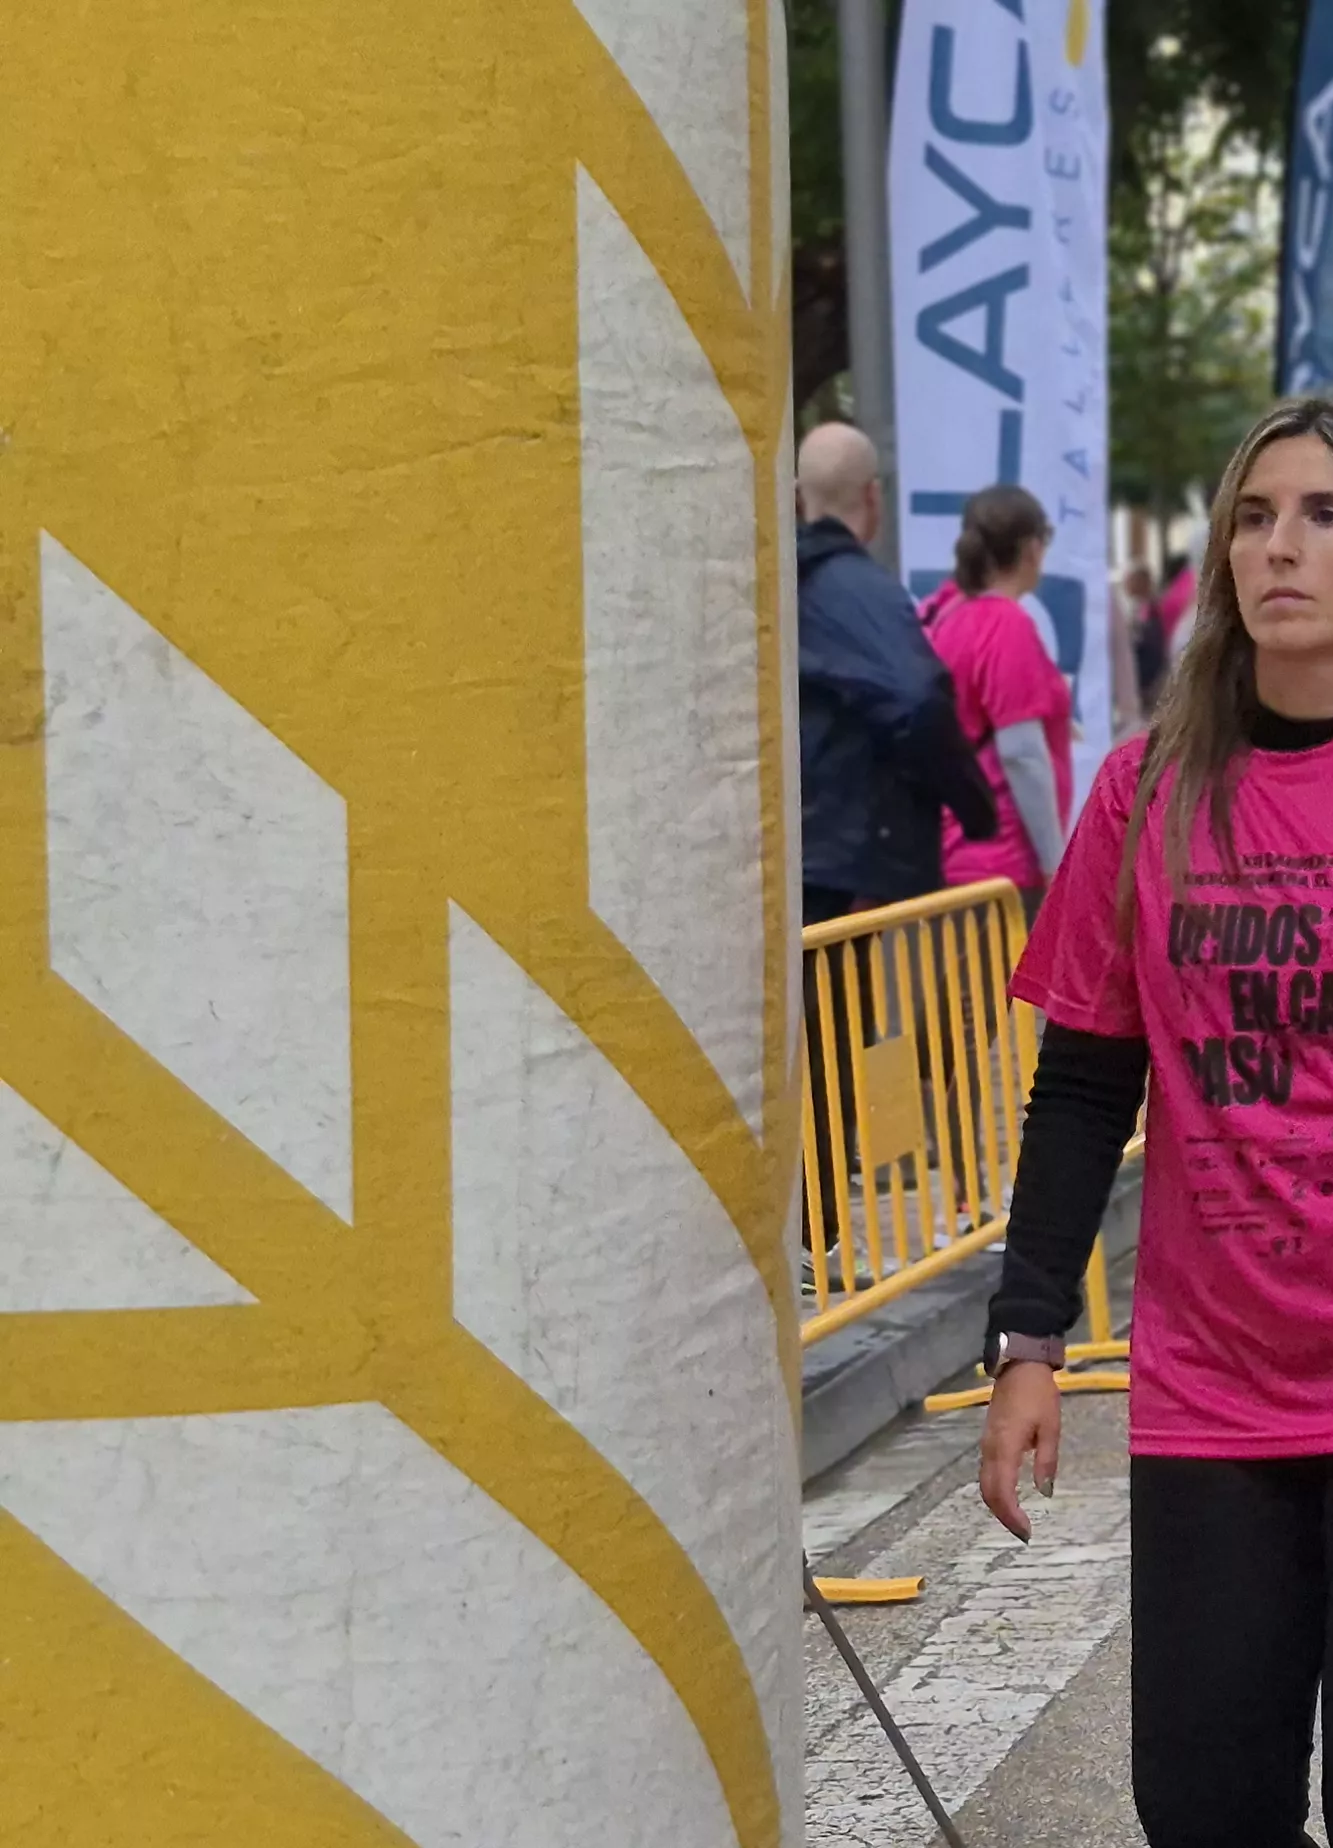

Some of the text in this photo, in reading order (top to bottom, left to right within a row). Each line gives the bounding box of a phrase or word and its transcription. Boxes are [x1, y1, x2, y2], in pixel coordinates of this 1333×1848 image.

[910, 0, 1035, 517] LAYC
[1167, 903, 1323, 967] UNIDOS
[1228, 970, 1281, 1031] EN
